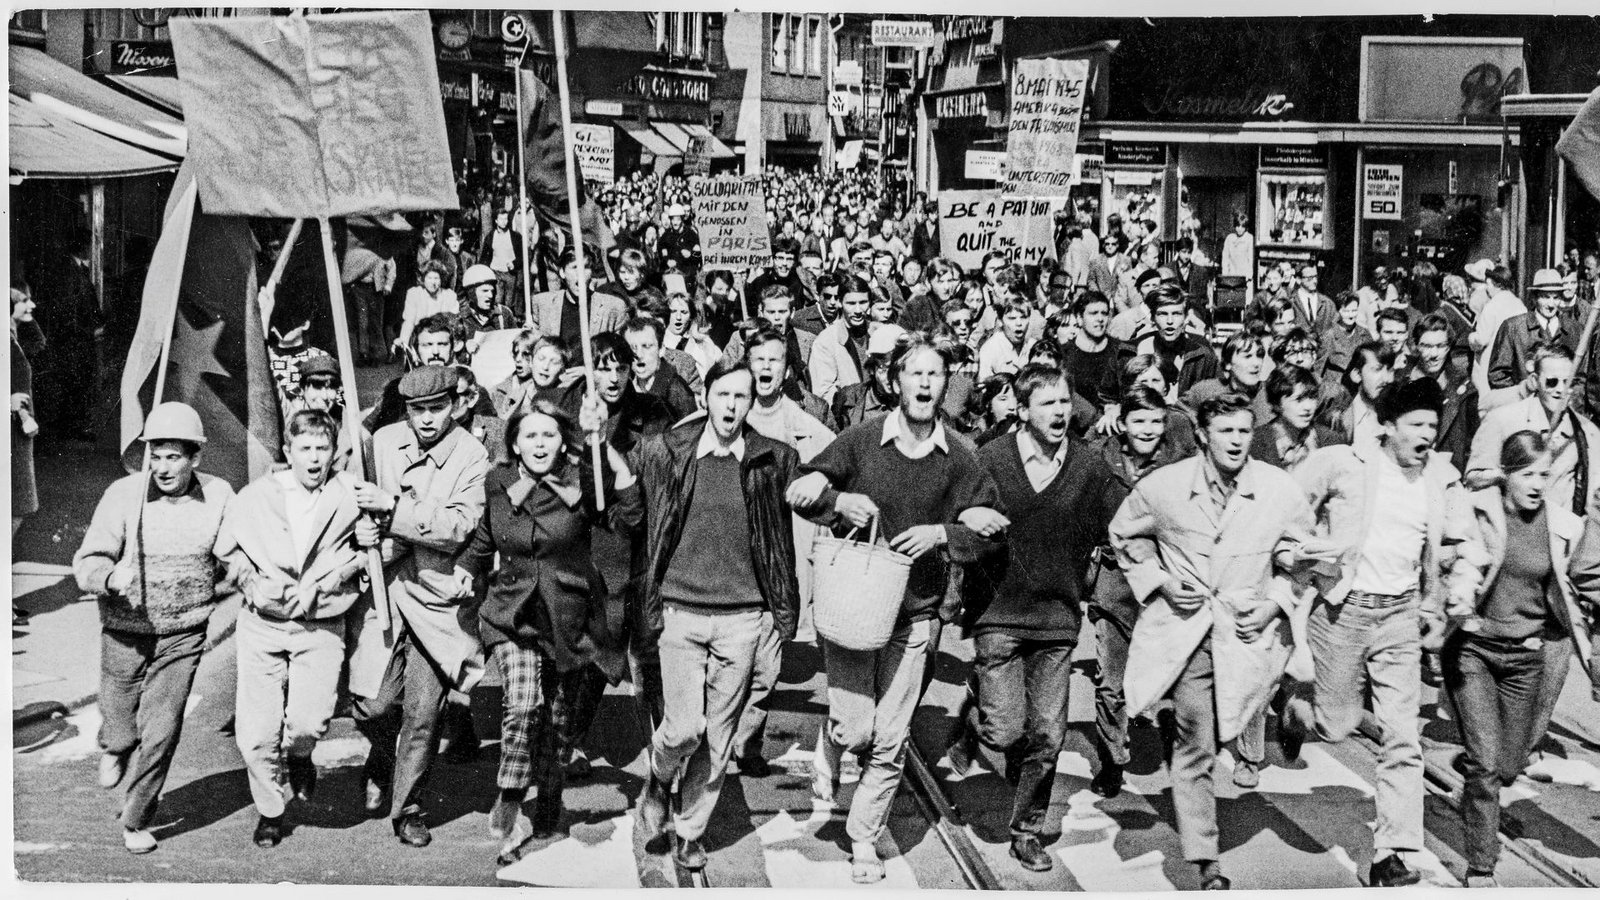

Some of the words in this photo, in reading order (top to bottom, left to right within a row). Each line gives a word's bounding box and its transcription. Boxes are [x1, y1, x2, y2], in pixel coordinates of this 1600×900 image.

[874, 24, 934, 37] RESTAURANT
[1010, 120, 1029, 132] DEN
[722, 201, 750, 213] DEN
[943, 202, 980, 219] BE
[986, 202, 996, 218] A
[698, 216, 747, 227] GENOSSEN
[978, 220, 1004, 229] AND
[719, 228, 733, 236] IN
[999, 237, 1016, 247] THE
[1004, 247, 1047, 264] ARMY
